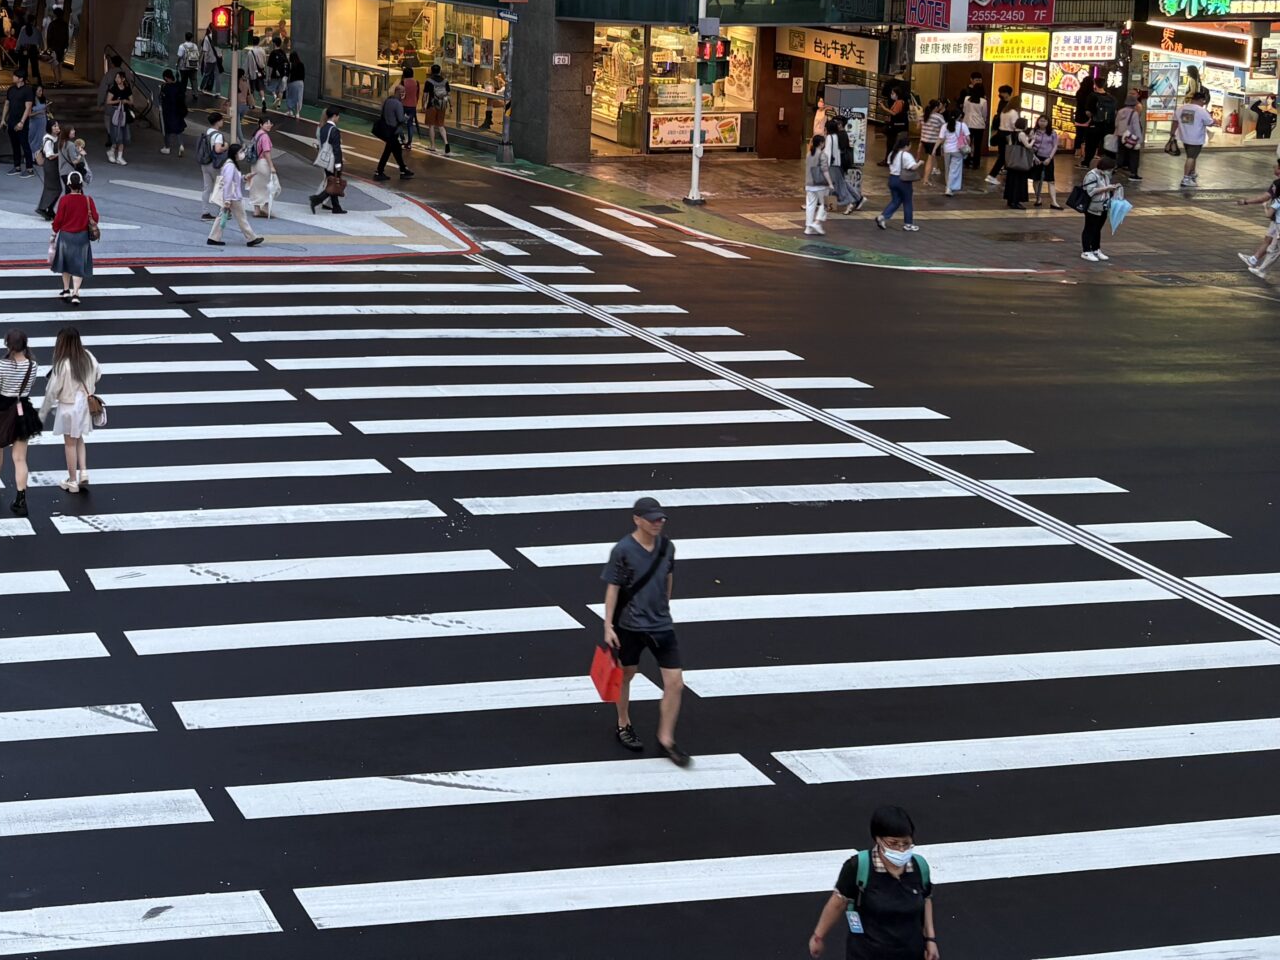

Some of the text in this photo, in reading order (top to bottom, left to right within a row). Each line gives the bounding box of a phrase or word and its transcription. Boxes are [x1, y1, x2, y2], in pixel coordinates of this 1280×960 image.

[1034, 10, 1047, 21] 7F
[813, 37, 865, 65] 台北牛乳大王
[920, 43, 974, 54] 健康機能館
